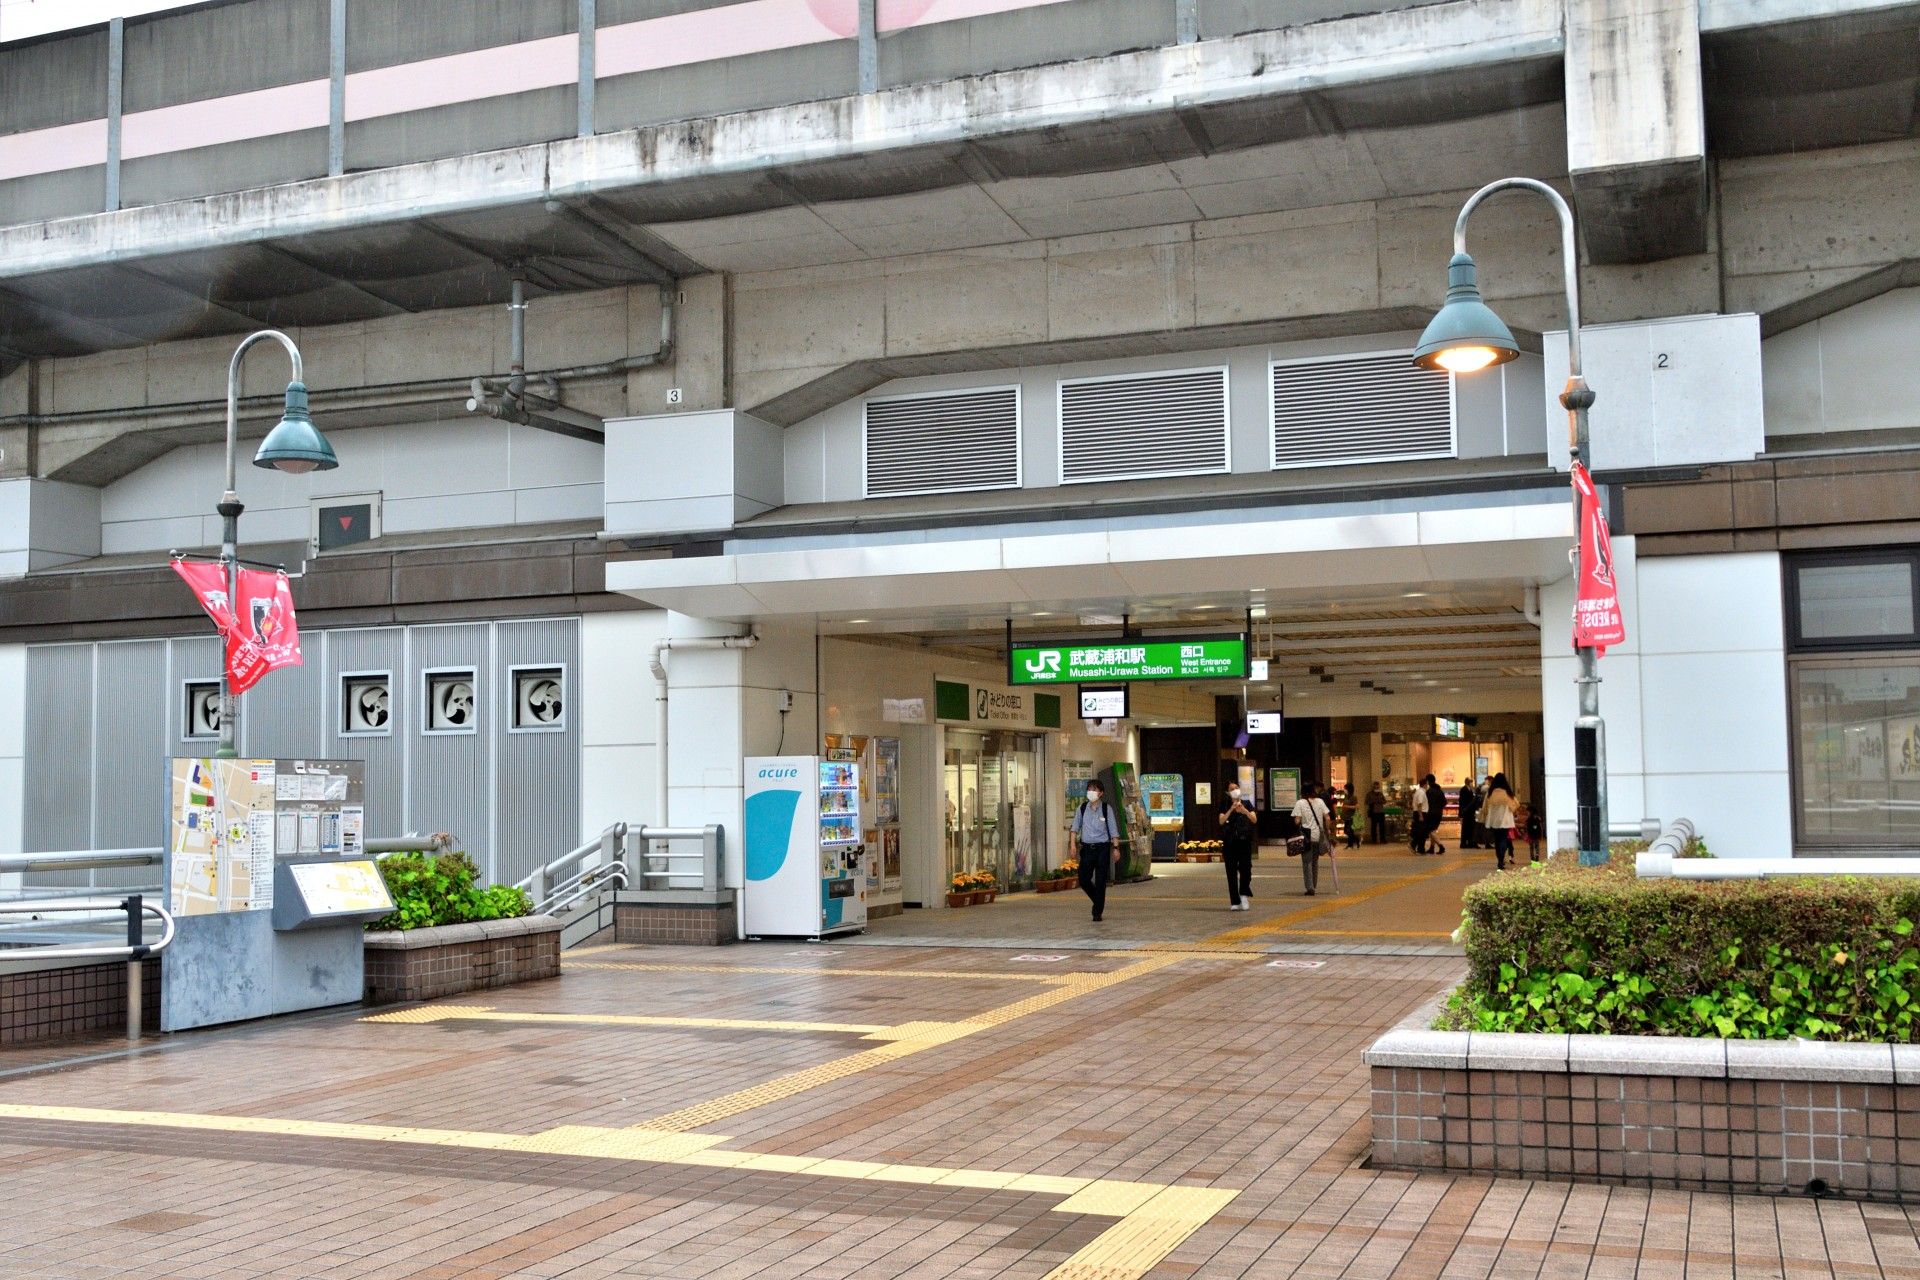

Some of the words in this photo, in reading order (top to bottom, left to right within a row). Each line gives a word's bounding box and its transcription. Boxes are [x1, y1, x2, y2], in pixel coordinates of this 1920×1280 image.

[1658, 353, 1669, 368] 2
[670, 390, 679, 402] 3
[1069, 647, 1146, 666] 武蔵浦和駅
[1180, 645, 1204, 658] 西口
[1025, 650, 1061, 673] JR
[1181, 659, 1199, 667] West
[1200, 658, 1231, 667] Entrance
[1069, 667, 1139, 678] Musashi-Urawa
[1141, 665, 1173, 675] Station
[758, 768, 798, 778] acure
